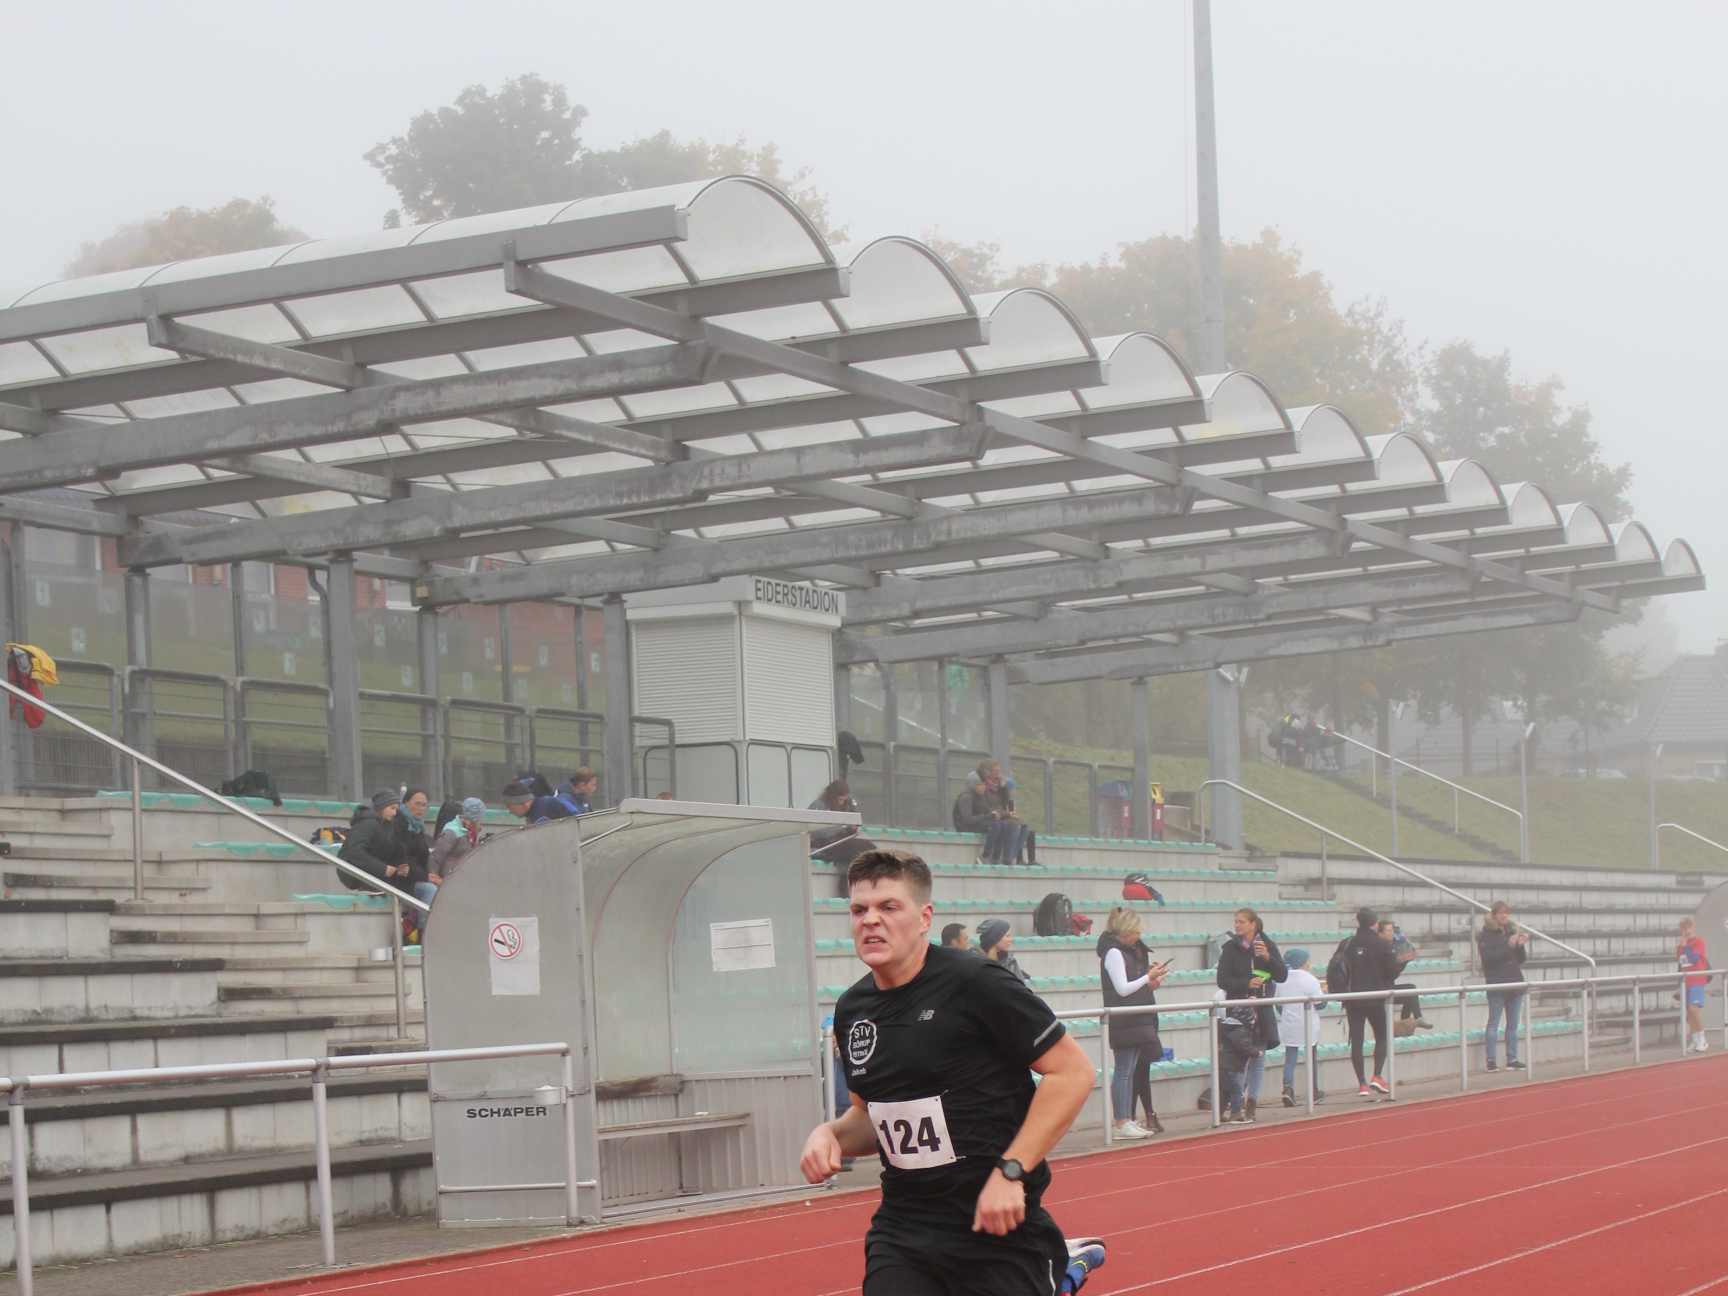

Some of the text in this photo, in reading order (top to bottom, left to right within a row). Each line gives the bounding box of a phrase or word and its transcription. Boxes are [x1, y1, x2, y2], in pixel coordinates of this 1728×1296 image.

[755, 579, 838, 614] EIDERSTADION
[854, 1026, 871, 1038] STV
[879, 1117, 941, 1154] 124
